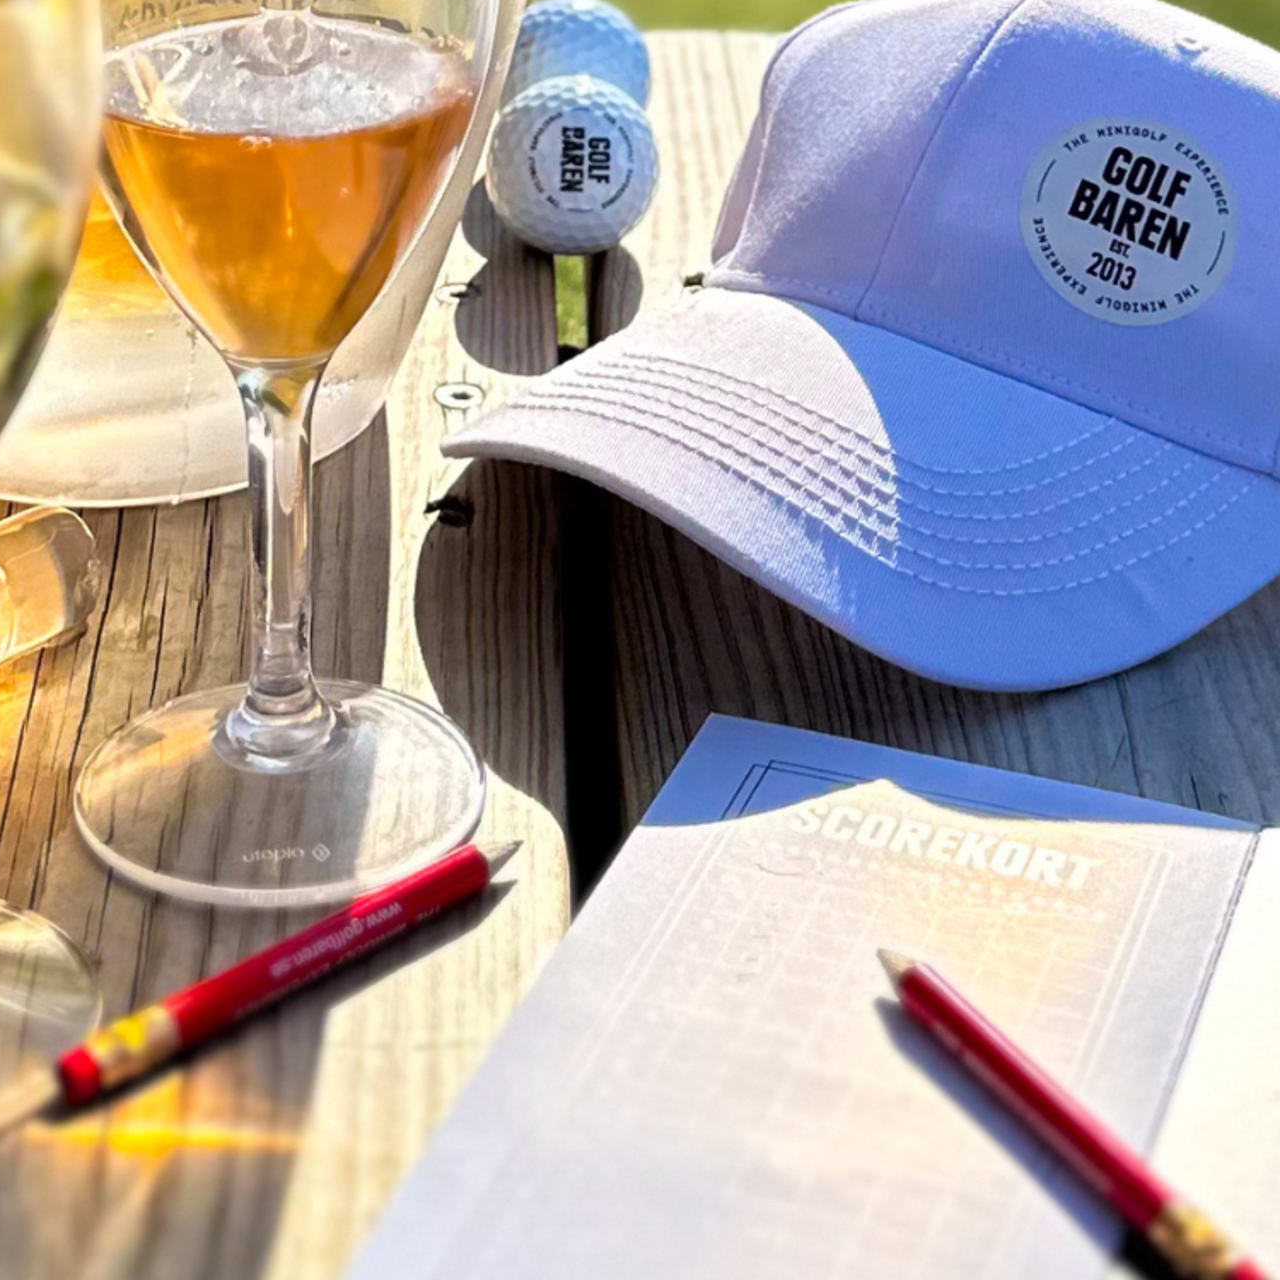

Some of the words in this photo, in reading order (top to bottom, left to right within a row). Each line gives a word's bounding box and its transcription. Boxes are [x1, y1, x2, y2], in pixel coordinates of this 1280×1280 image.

[559, 126, 586, 193] BAREN
[587, 136, 612, 185] GOLF
[1063, 133, 1090, 153] THE
[1096, 125, 1168, 142] MINIGOLF
[1174, 141, 1230, 216] EXPERIENCE
[1102, 146, 1193, 209] GOLF
[1068, 178, 1192, 262] BAREN
[1033, 217, 1088, 296] EXPERIENCE
[1085, 252, 1138, 292] 2013
[1095, 295, 1168, 313] MINIGOLF
[1174, 283, 1201, 305] THE
[789, 801, 1102, 889] SCOREKORT
[271, 901, 403, 980] www.golfbaren.se
